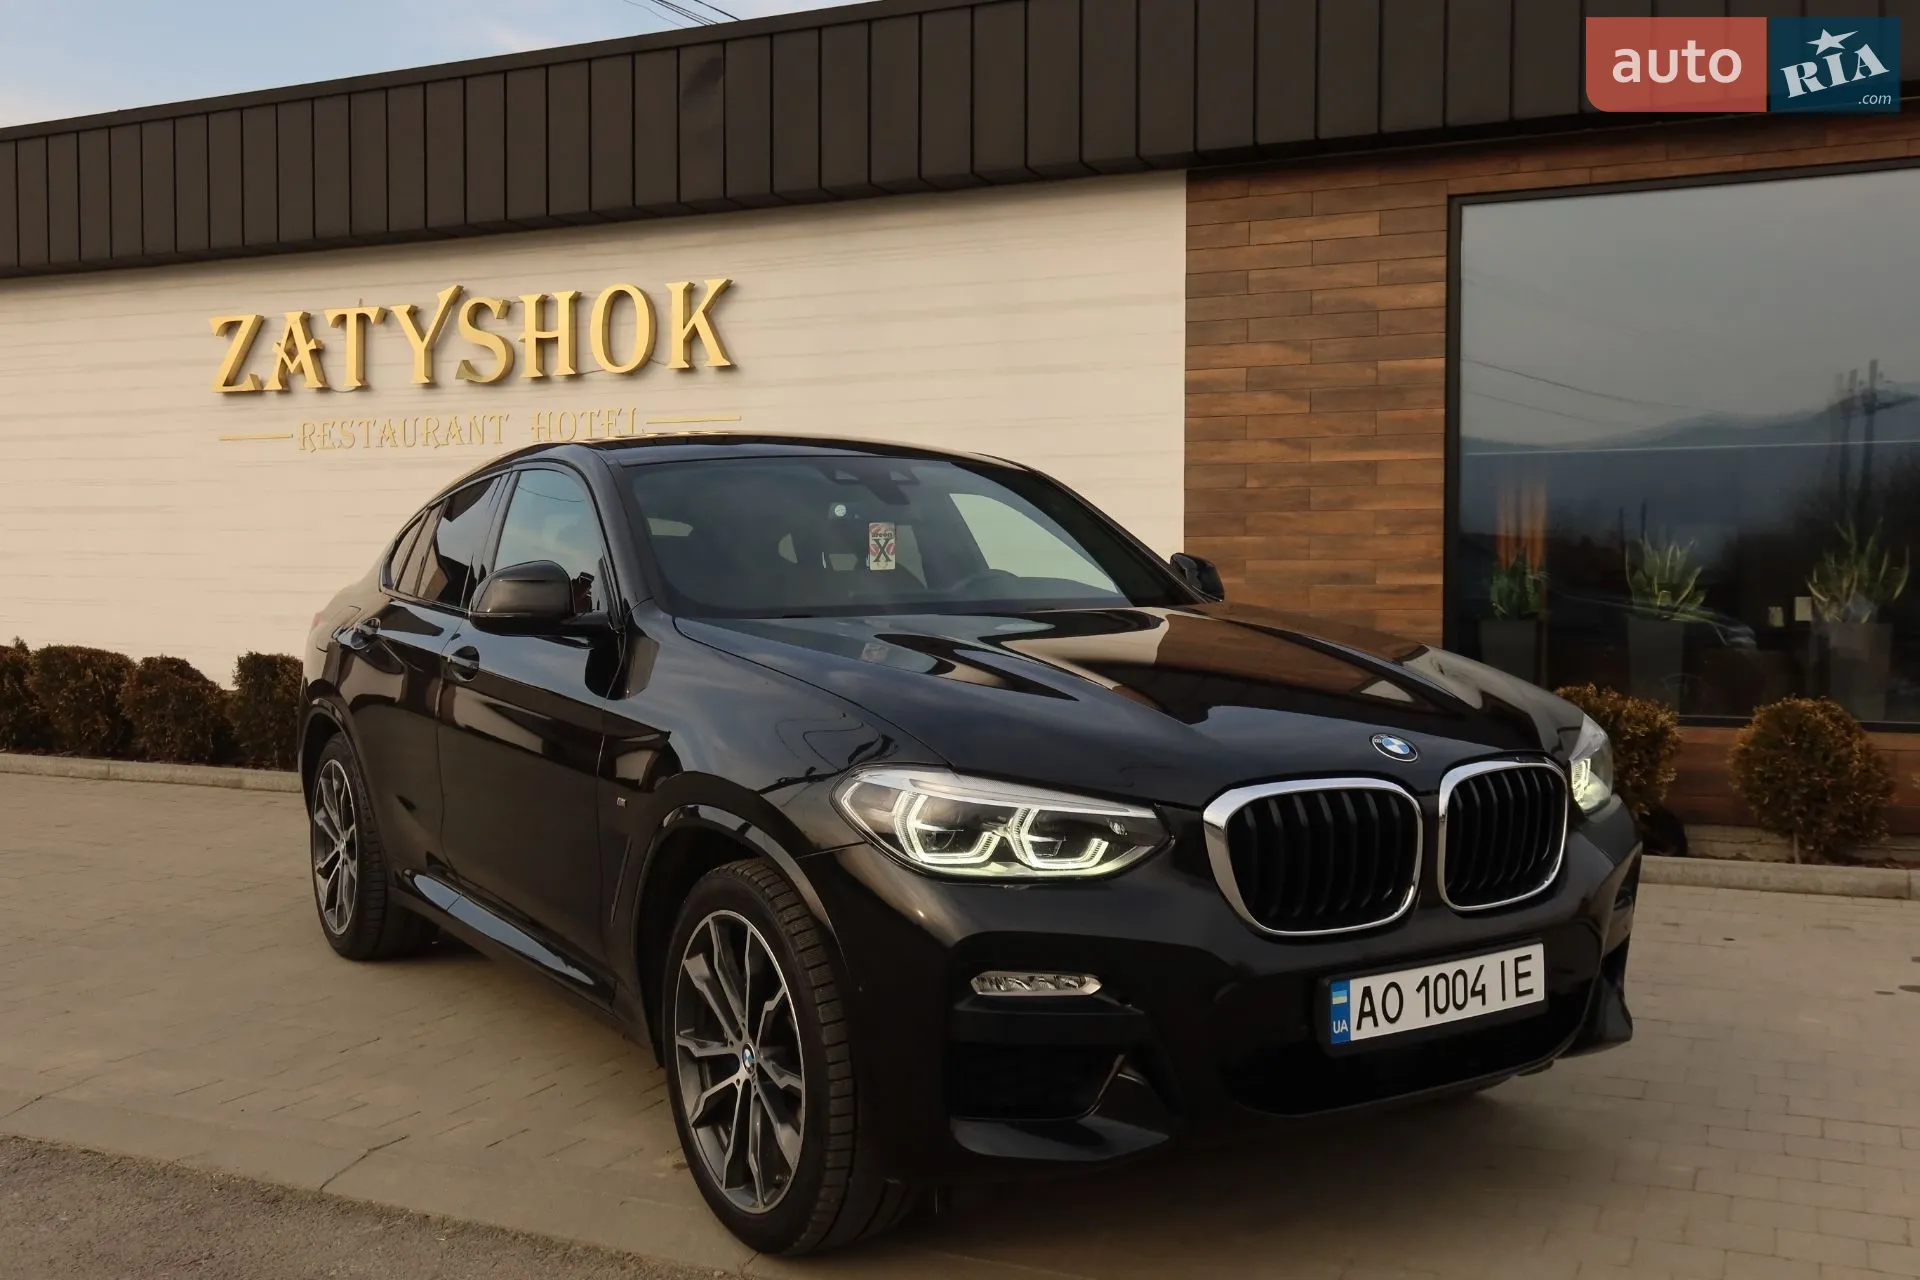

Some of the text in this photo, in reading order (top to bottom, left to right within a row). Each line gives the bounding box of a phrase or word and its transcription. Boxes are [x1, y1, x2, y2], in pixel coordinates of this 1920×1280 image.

[209, 278, 737, 393] ZATYSHOK
[298, 406, 646, 453] RESTAURANT HOTEL
[1356, 954, 1535, 1031] AO 1004 IE
[1333, 1020, 1349, 1034] UA
